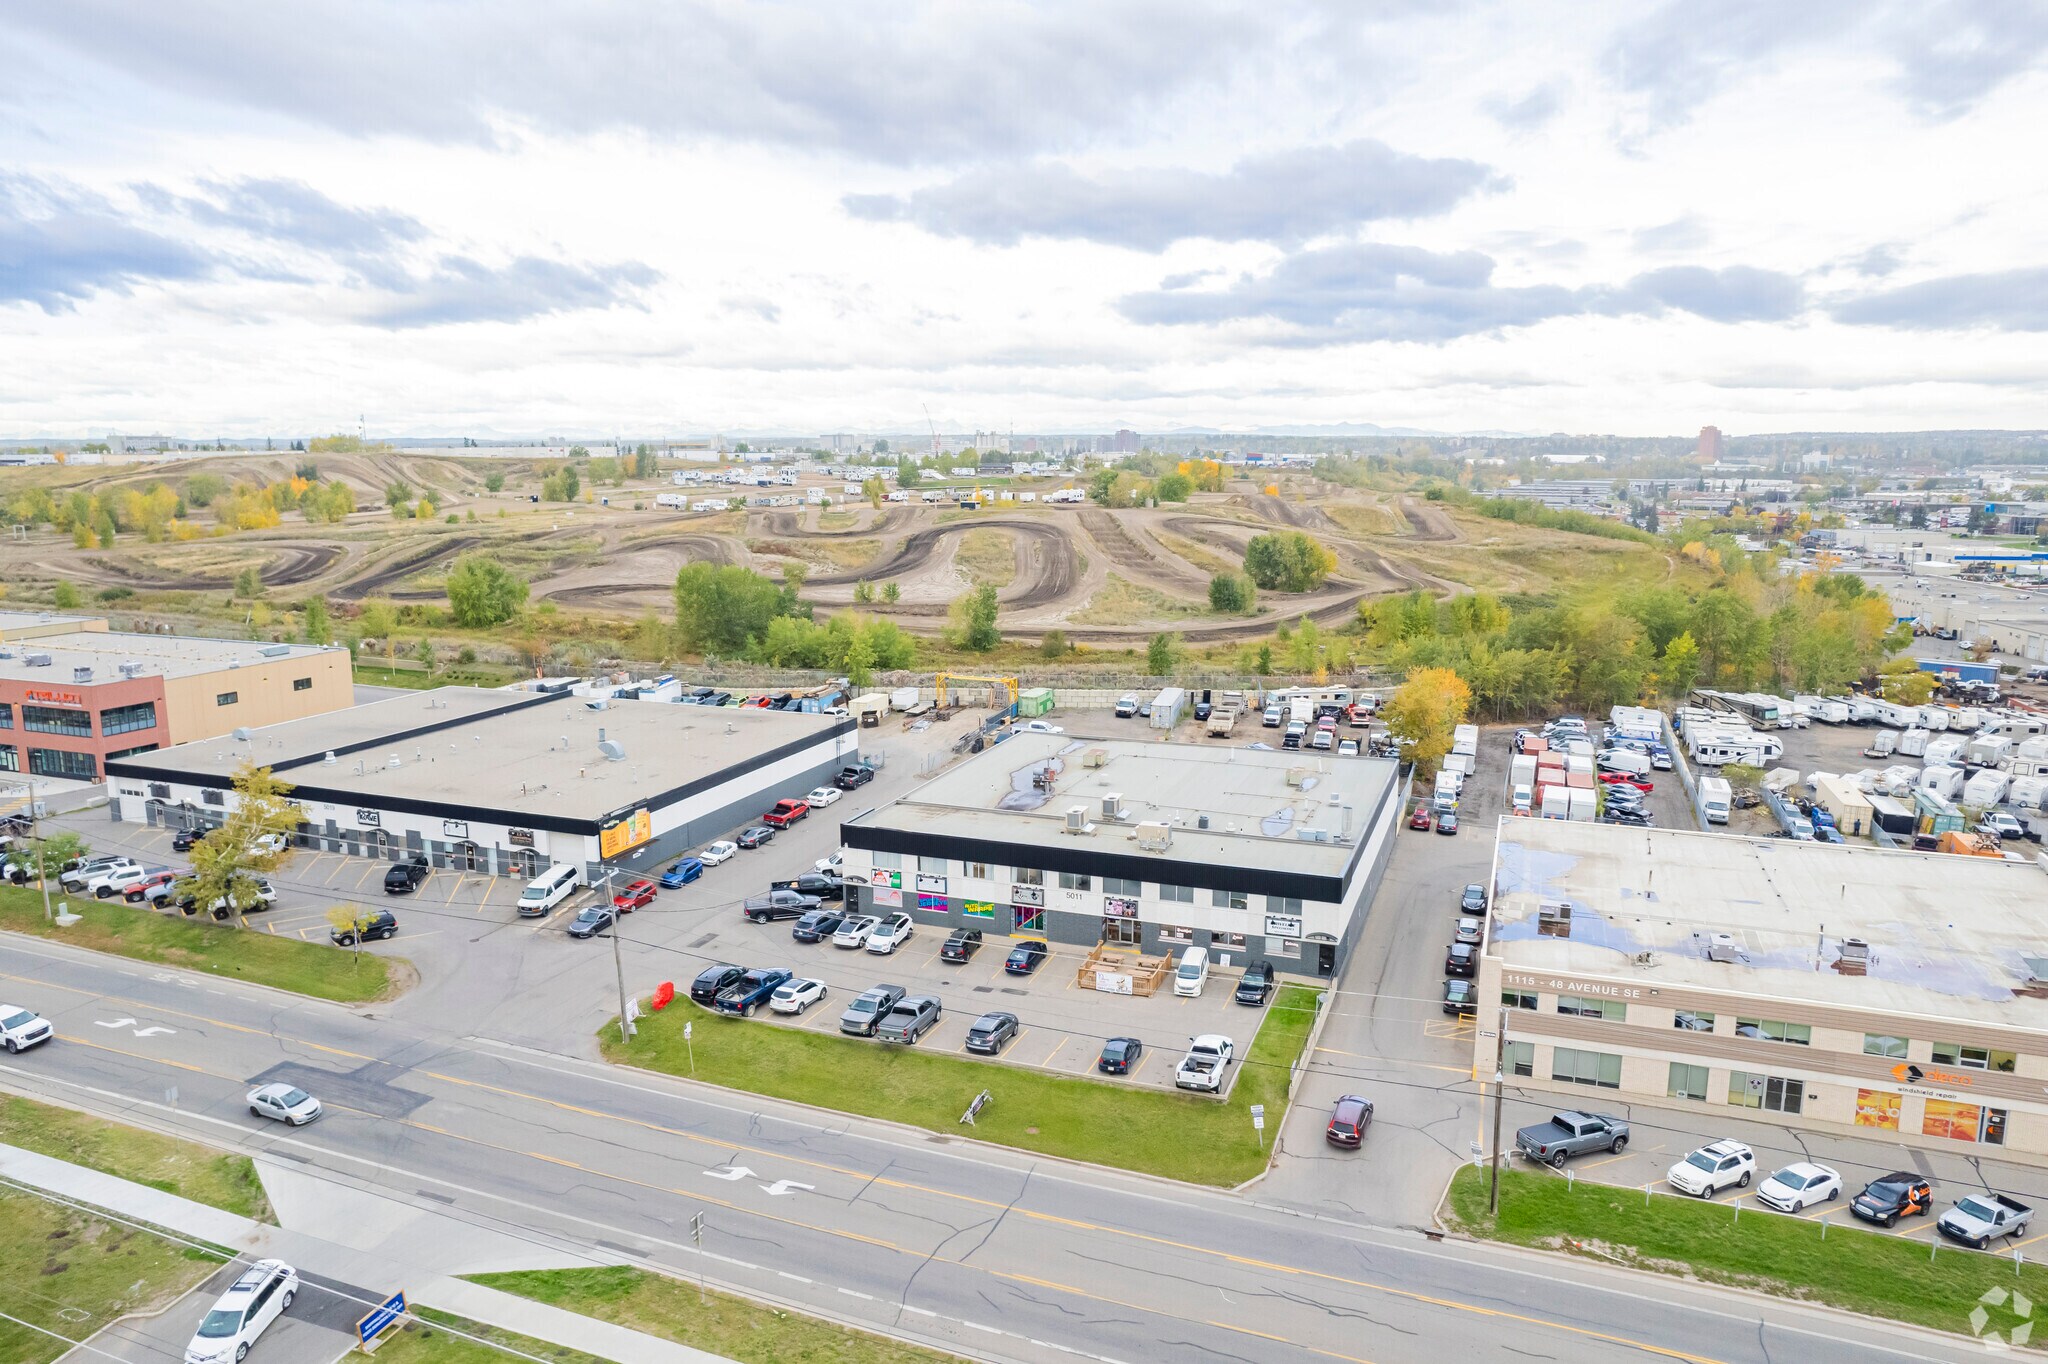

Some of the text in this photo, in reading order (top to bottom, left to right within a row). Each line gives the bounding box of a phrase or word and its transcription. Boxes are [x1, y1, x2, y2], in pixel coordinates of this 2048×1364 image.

[1066, 892, 1082, 900] 5011
[1508, 975, 1535, 986] 1115
[1549, 980, 1563, 989] 48
[1567, 982, 1618, 996] AVENUE
[1624, 989, 1640, 998] SE
[1925, 1068, 1973, 1086] deco
[1897, 1087, 1957, 1100] windshield repair
